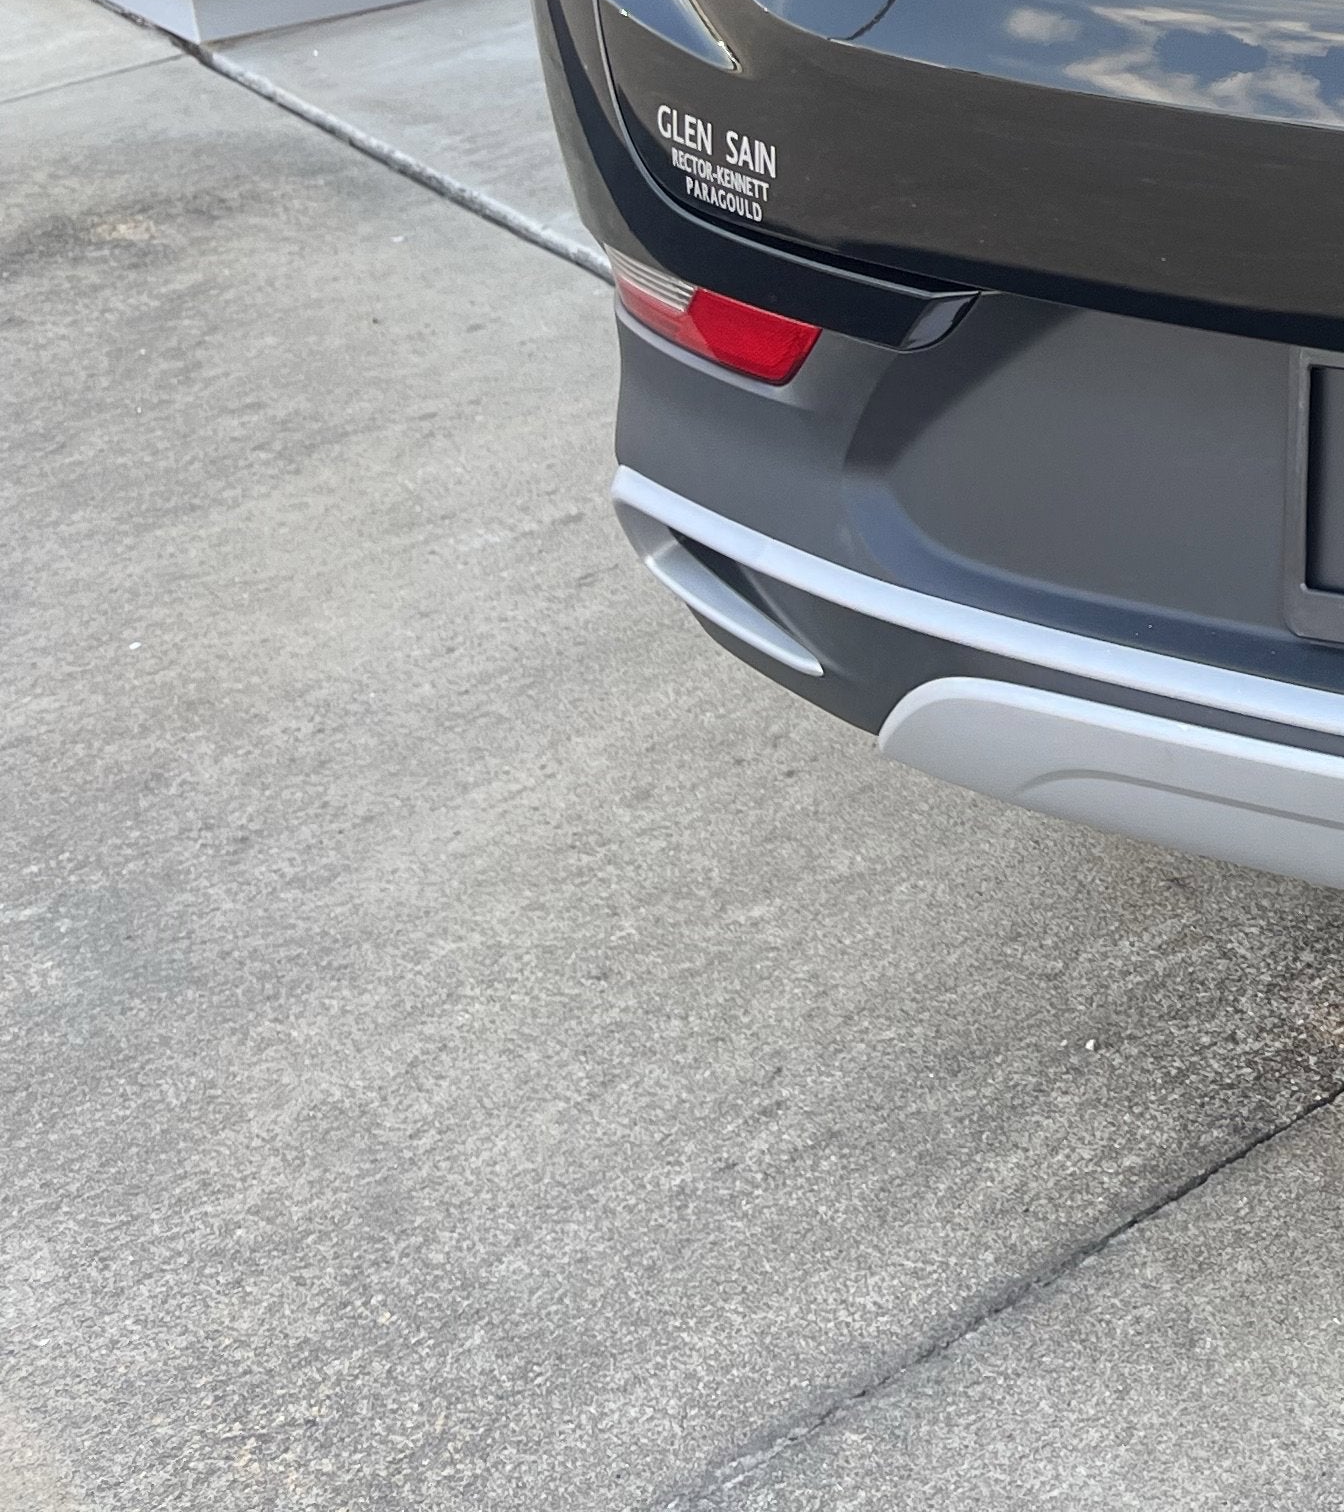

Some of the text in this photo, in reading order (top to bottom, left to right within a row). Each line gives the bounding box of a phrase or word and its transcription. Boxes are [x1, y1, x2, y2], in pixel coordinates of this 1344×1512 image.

[657, 104, 777, 179] GLEN SAIN
[671, 146, 770, 202] RECTOR-KENNETT
[685, 176, 763, 222] PARAGOULD
